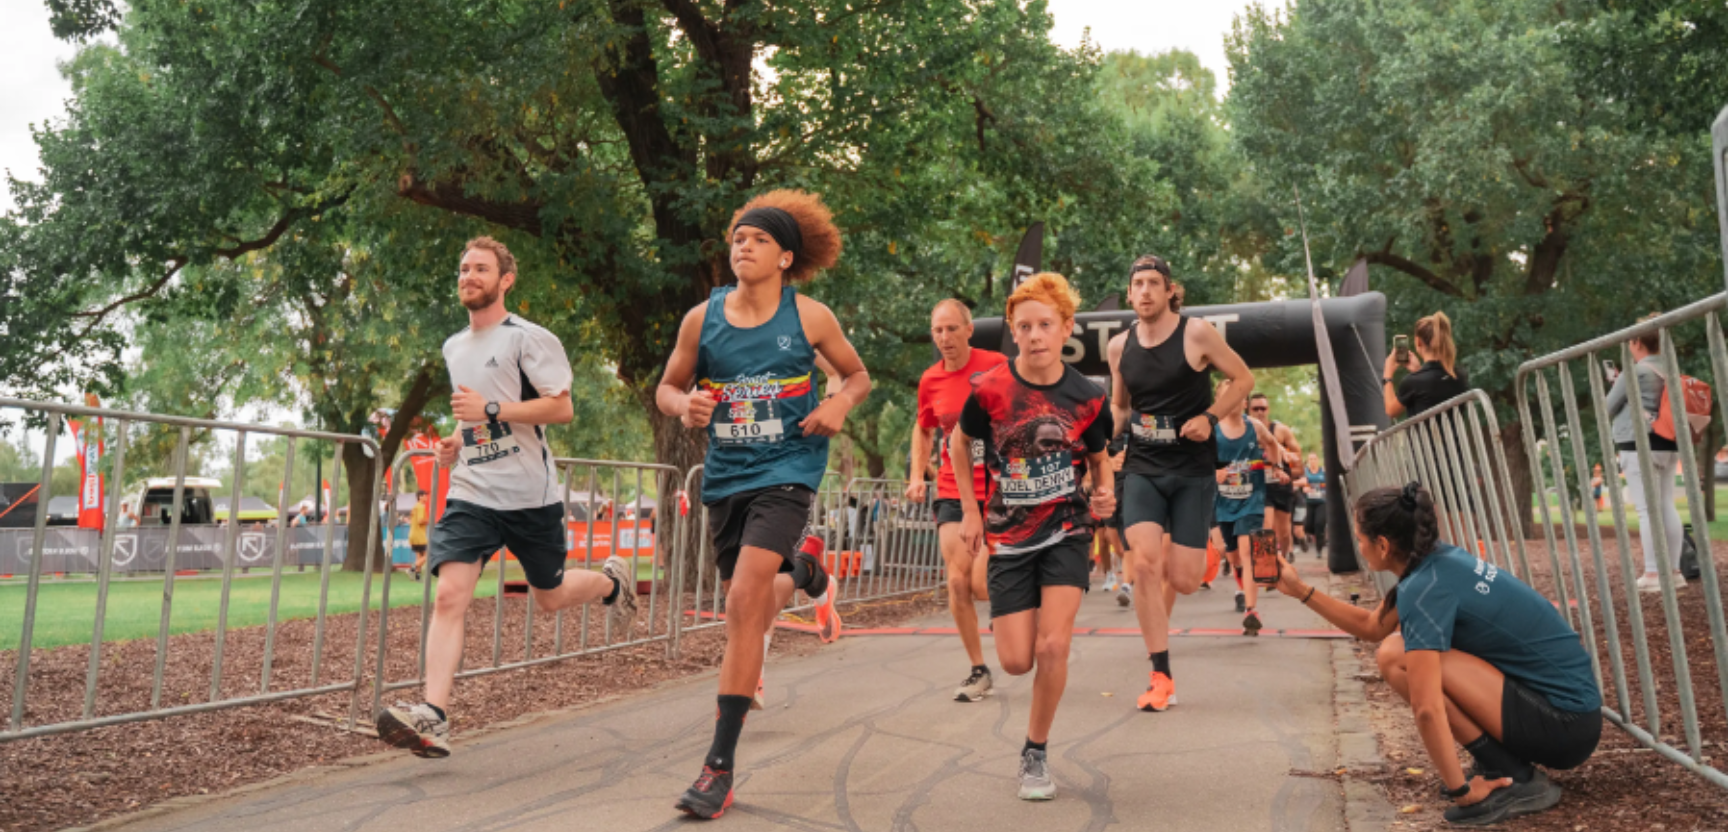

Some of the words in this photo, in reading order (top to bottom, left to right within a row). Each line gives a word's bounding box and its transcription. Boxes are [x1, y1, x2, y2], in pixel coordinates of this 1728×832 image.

[1061, 313, 1240, 364] STT
[730, 423, 761, 438] 610
[1004, 480, 1032, 492] JOEL
[1034, 468, 1072, 490] DENNY
